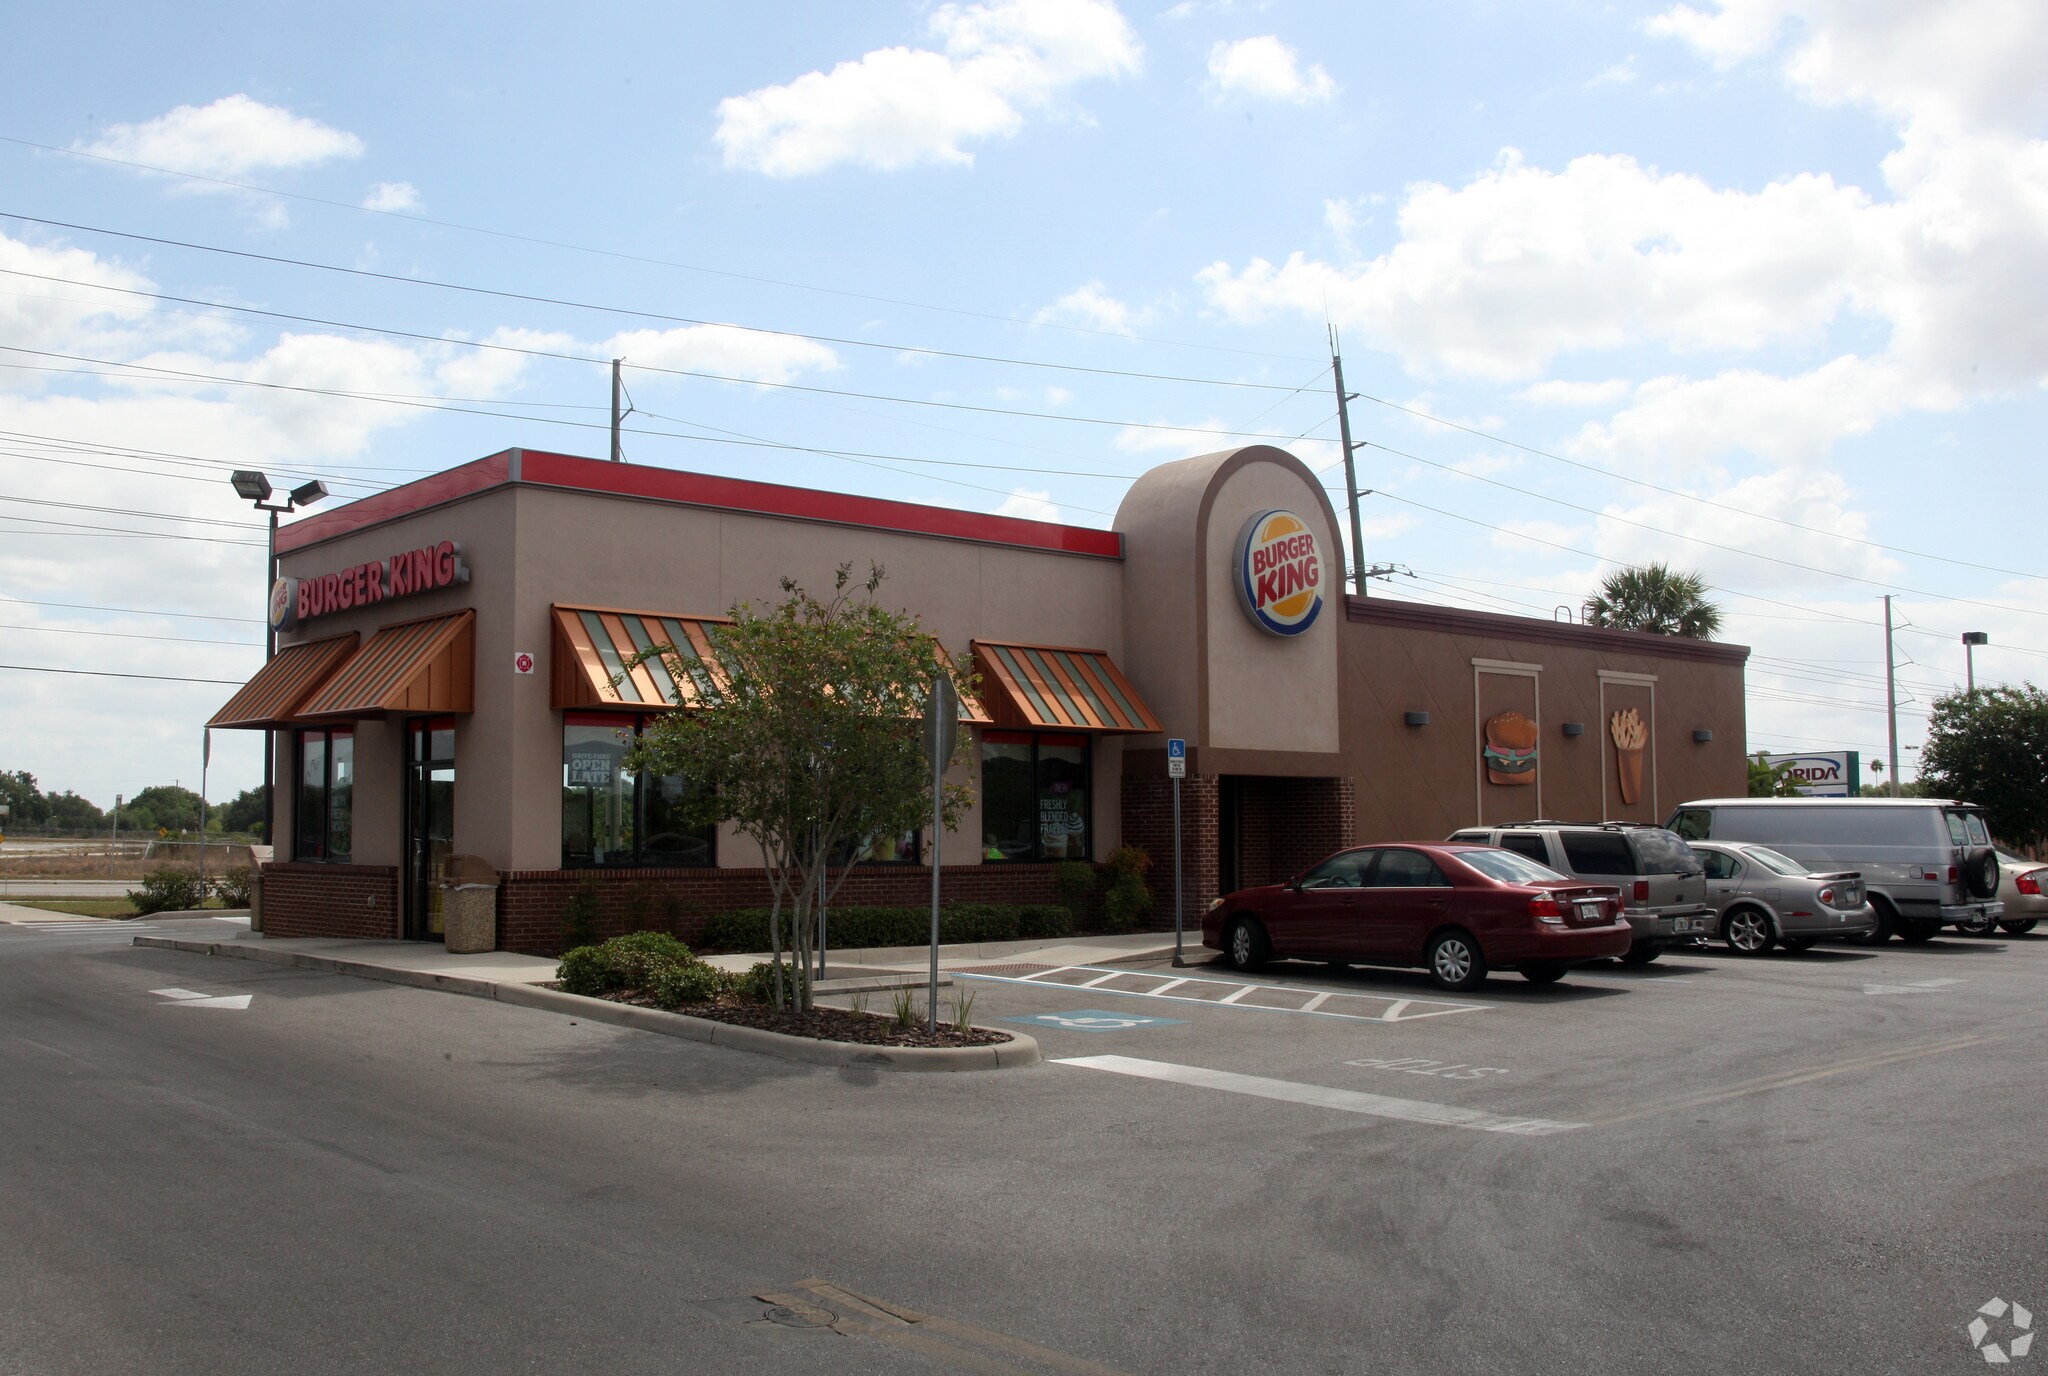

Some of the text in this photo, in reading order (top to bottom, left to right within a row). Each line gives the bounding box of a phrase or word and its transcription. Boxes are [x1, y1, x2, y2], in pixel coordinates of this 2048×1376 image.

[1253, 534, 1315, 576] BURGER
[298, 541, 456, 619] BURGER KING
[1257, 556, 1319, 609] KING
[572, 759, 611, 770] OPEN
[572, 770, 610, 783] LATE
[1780, 767, 1839, 781] ORIDA
[1055, 783, 1069, 793] NEW
[1040, 799, 1068, 810] FRESHLY
[1040, 811, 1069, 822] BLENDED
[1342, 1057, 1510, 1080] STOP
